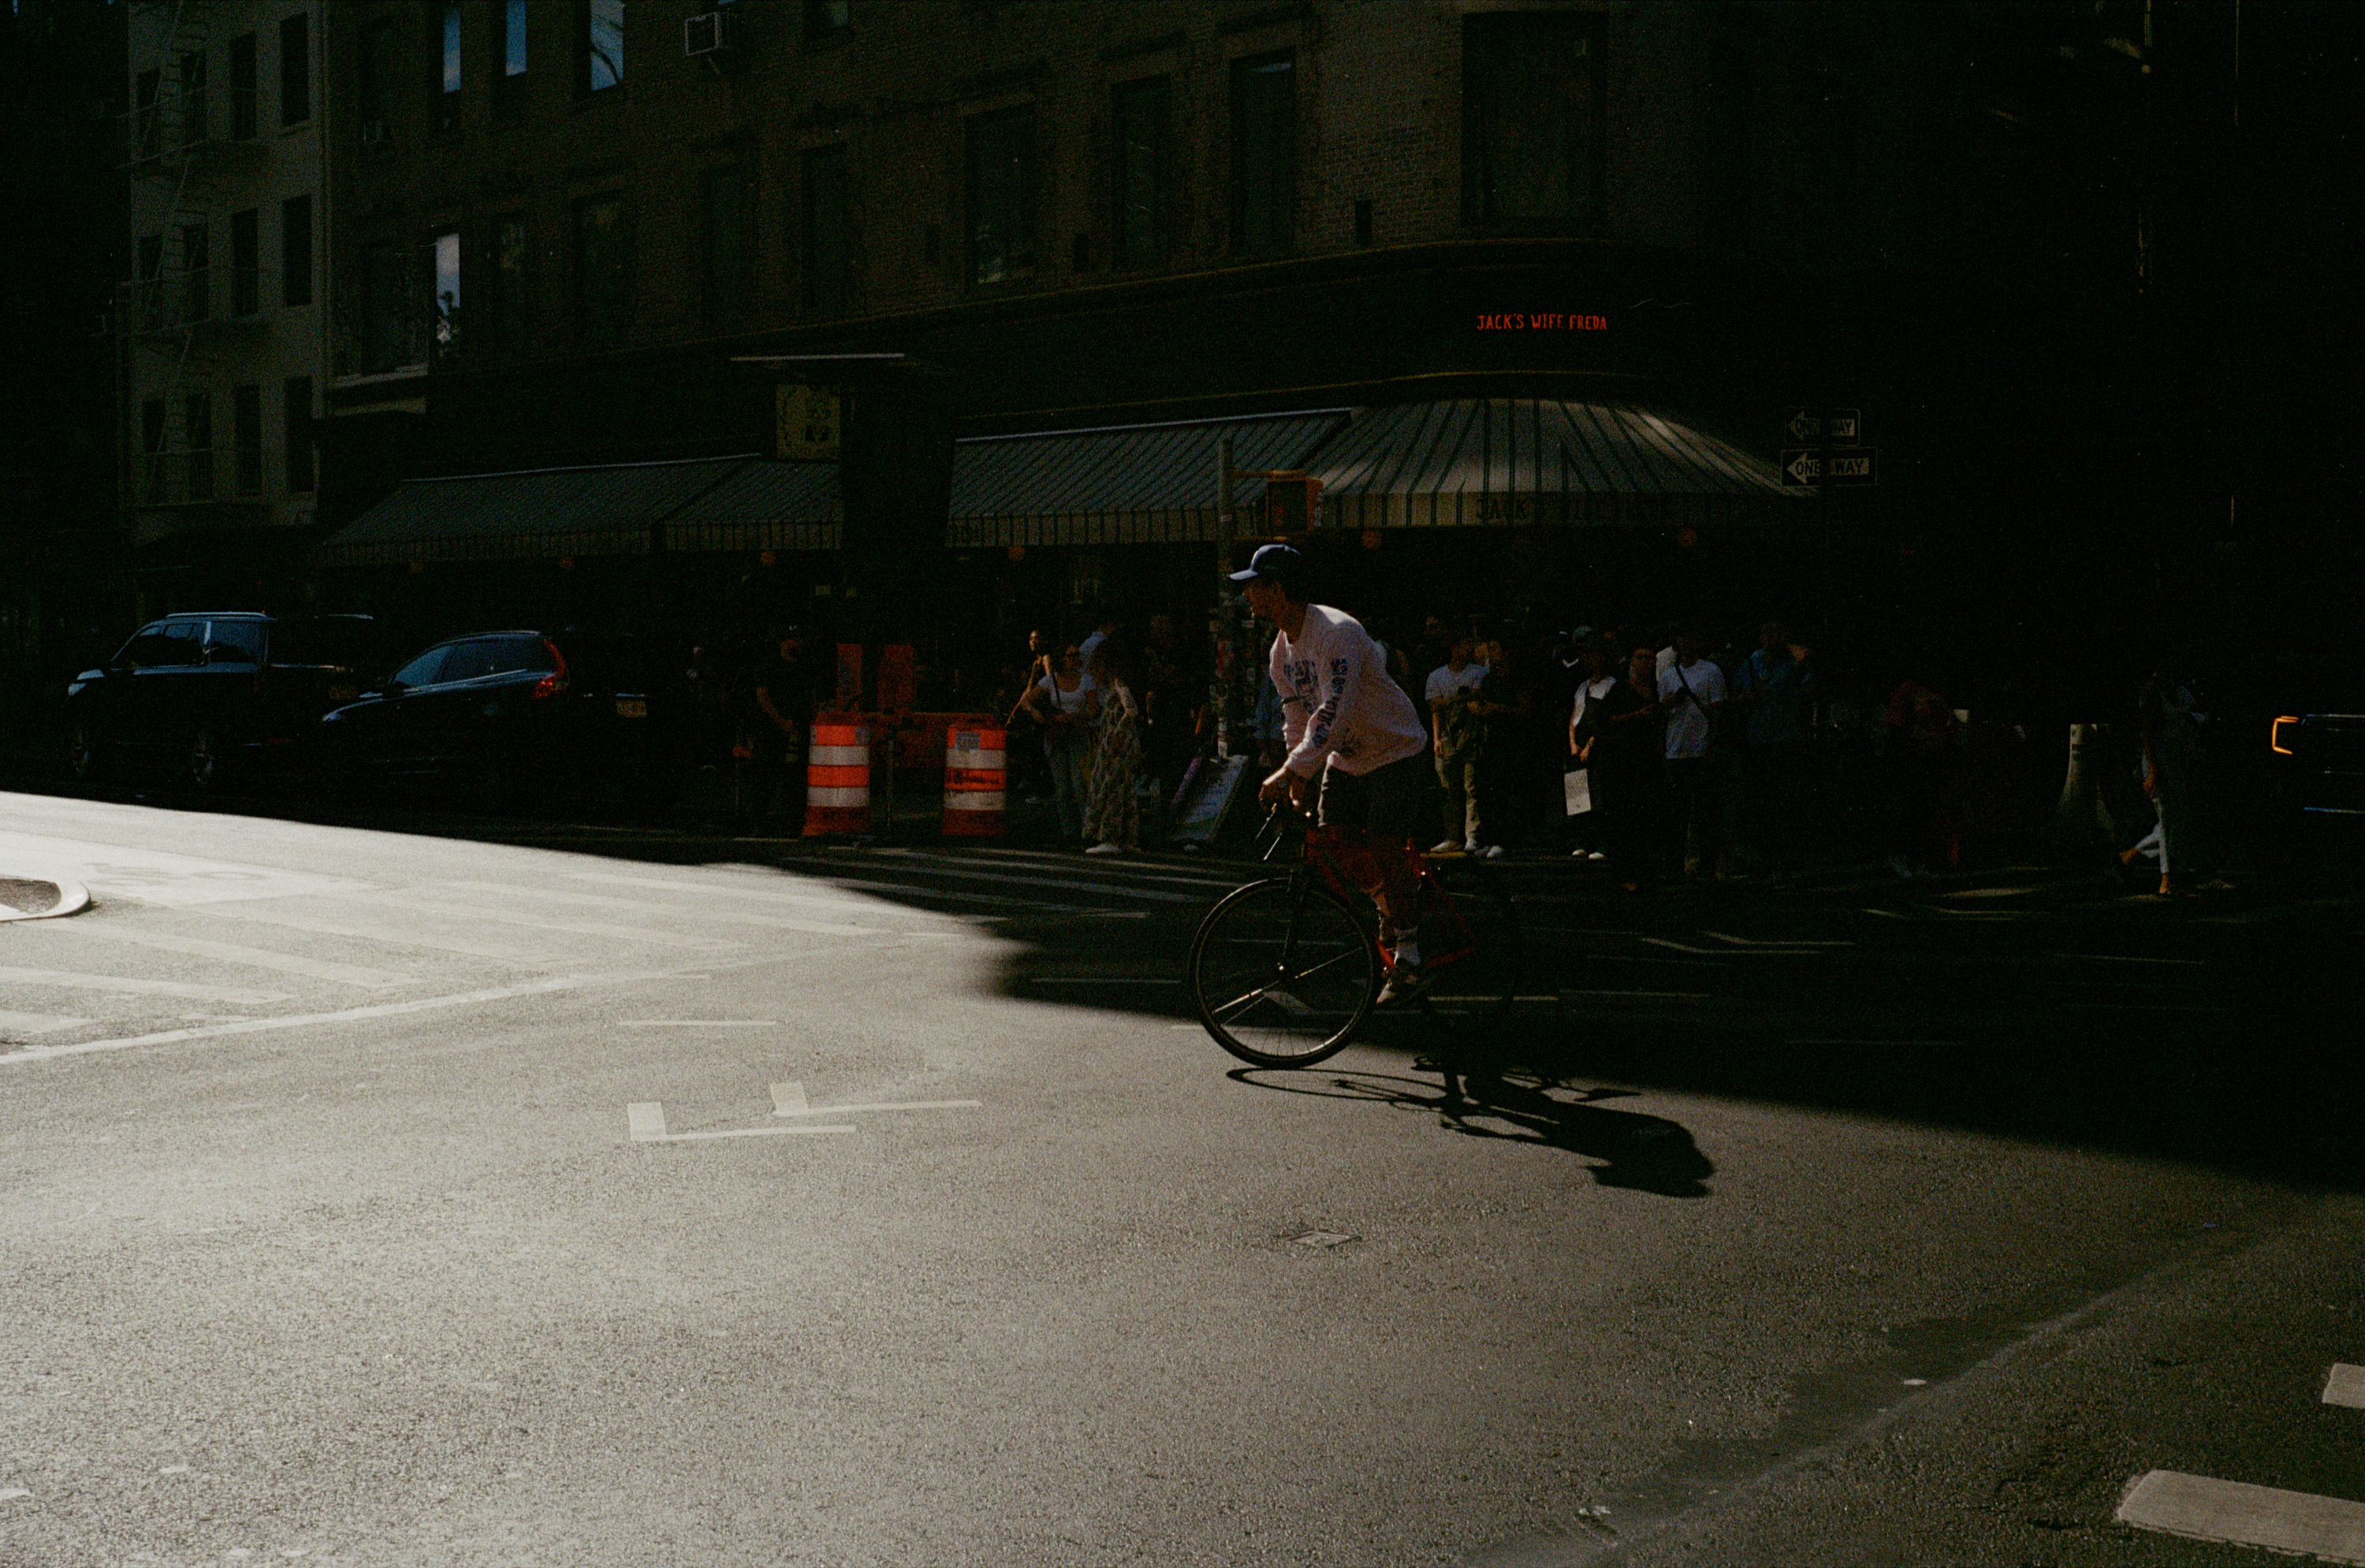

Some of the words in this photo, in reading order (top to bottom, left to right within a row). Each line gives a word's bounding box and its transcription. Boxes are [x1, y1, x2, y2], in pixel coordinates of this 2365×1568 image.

[1476, 313, 1524, 331] JACK'S
[1529, 313, 1563, 330] WIFE
[1568, 314, 1607, 331] FREDA
[1795, 419, 1819, 434] ONE
[1830, 419, 1853, 434] WAY
[1795, 460, 1820, 476] ONE
[1834, 459, 1863, 475] WAY
